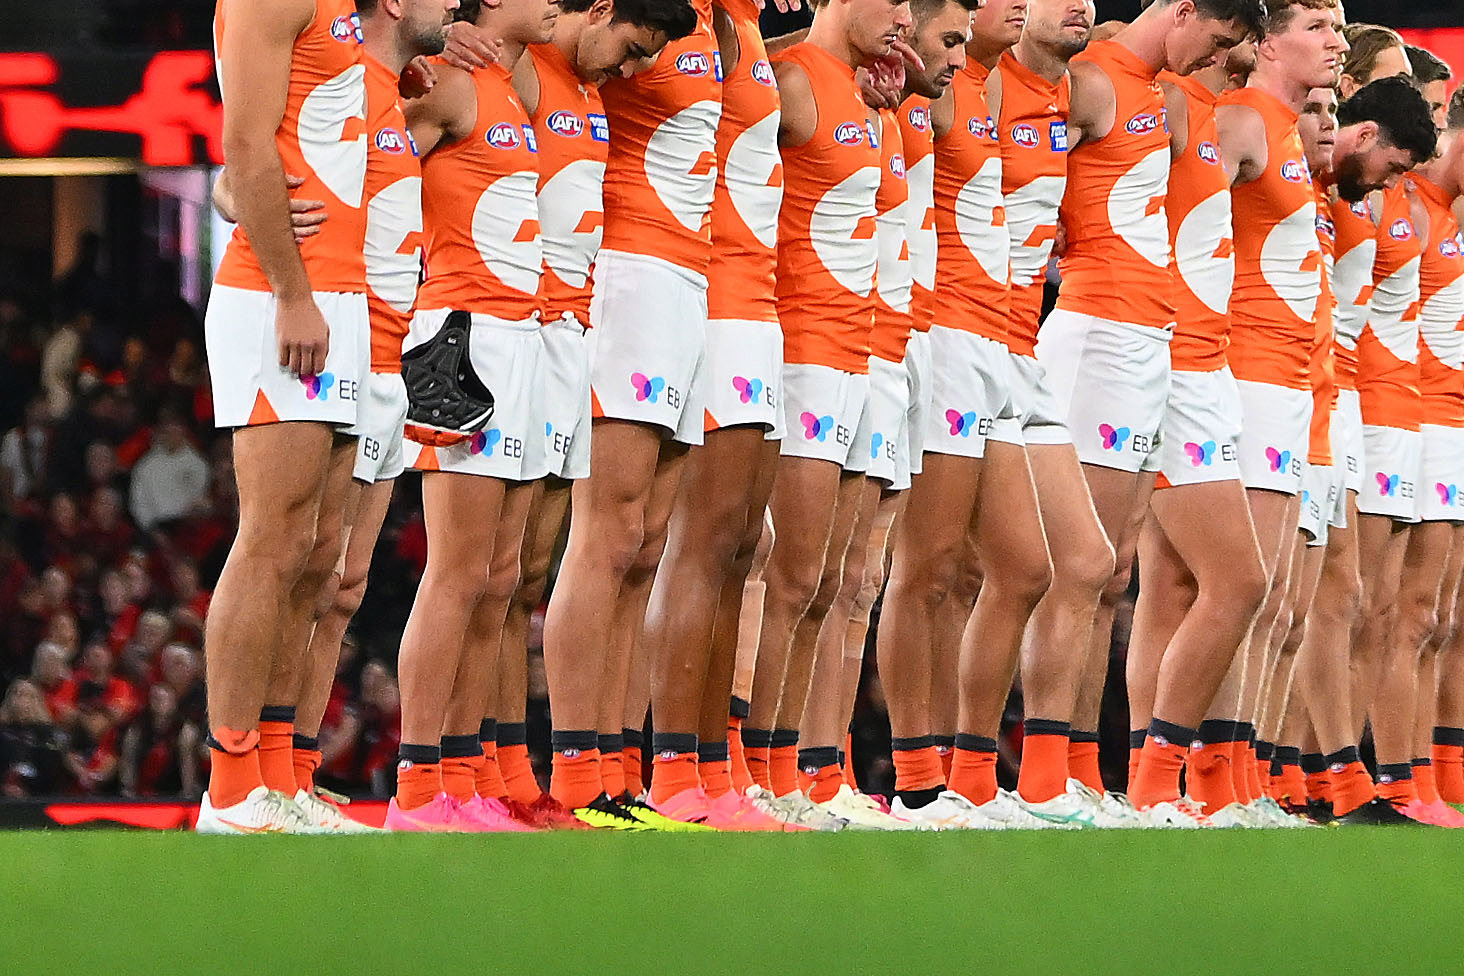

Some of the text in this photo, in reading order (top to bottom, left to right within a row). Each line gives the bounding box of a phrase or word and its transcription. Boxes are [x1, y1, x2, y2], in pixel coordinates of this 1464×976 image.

[667, 386, 680, 409] EB
[364, 437, 380, 461] EB
[504, 436, 522, 459] EB
[1132, 434, 1149, 453] EB
